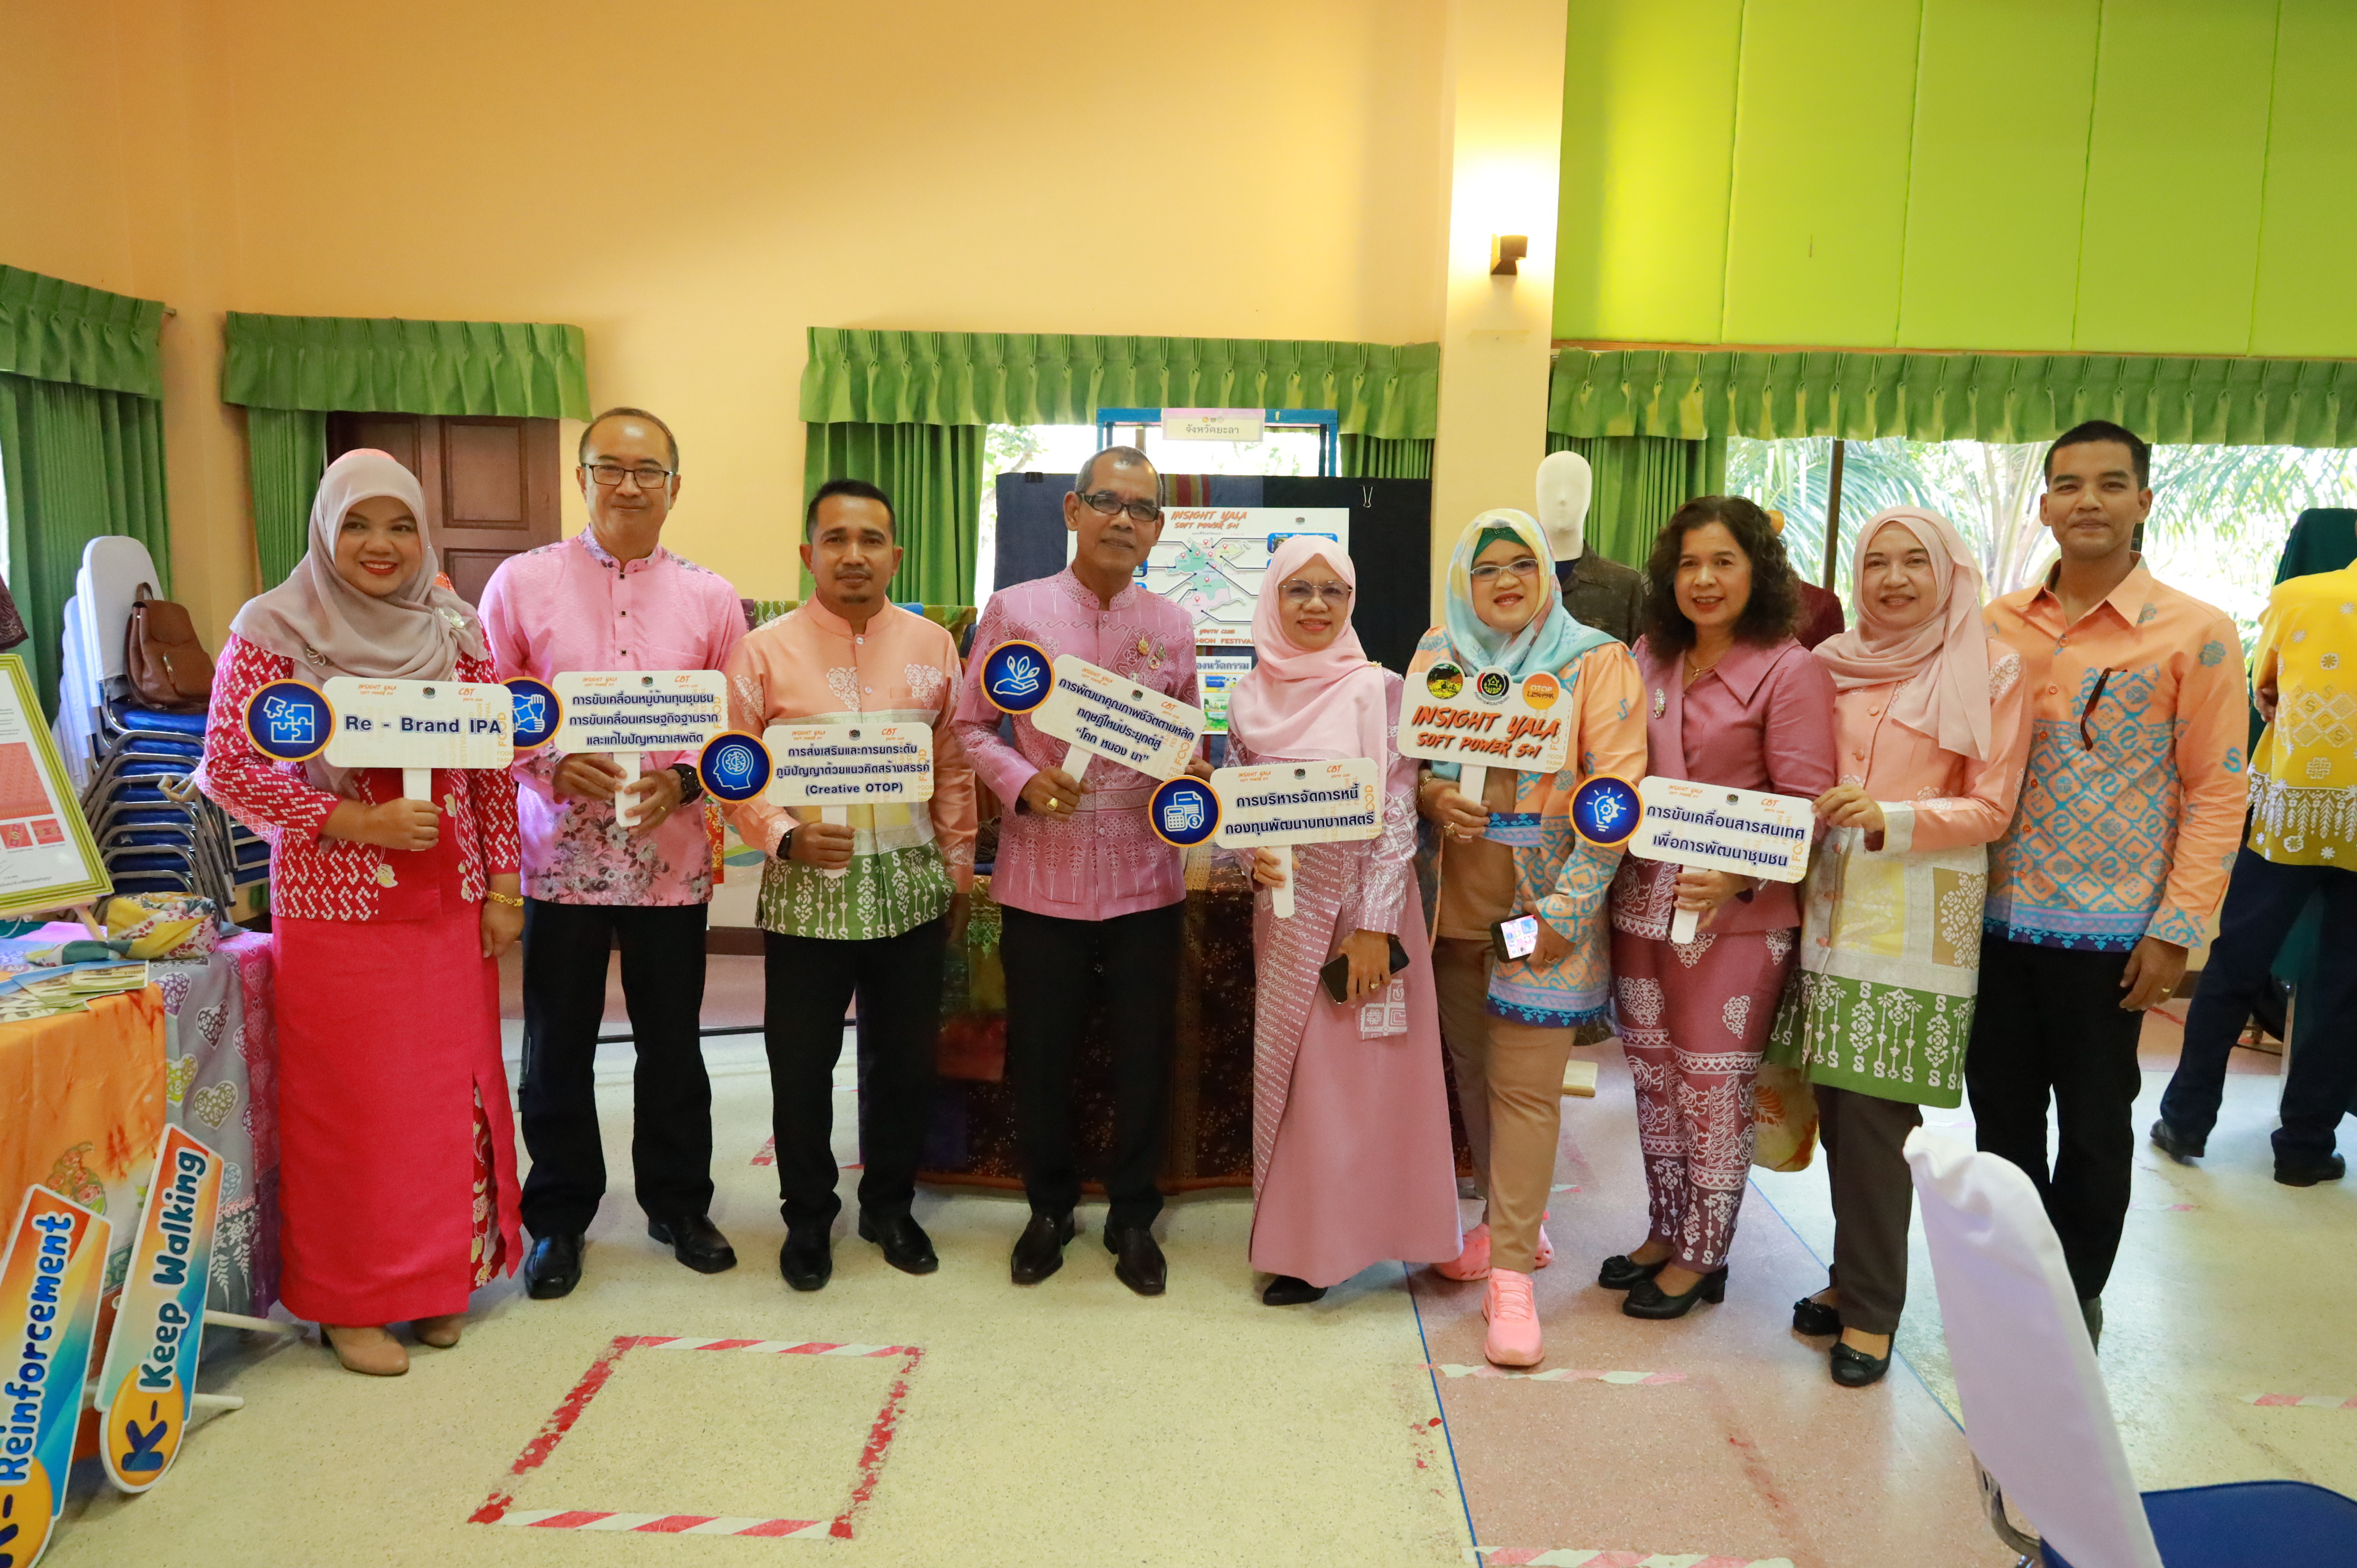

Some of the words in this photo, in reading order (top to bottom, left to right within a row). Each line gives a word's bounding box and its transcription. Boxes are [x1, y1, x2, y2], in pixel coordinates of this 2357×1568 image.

[1186, 424, 1239, 434] จังหวัดยะลา
[1171, 511, 1217, 520] INSIGHT
[1221, 512, 1248, 523] YALA
[1197, 659, 1249, 670] องนวัตกรรม
[1082, 668, 1101, 678] INSIGHT
[1101, 675, 1113, 684] YALA
[572, 691, 714, 706] การขับเคลื่อนหมู่บ้านทุนชุมชน
[1161, 701, 1177, 711] CBT
[569, 711, 718, 726] การขับเคลื่อนเศรษฐกิจฐานราก
[1058, 679, 1194, 741] การพัฒนาคุณภาพชีวิตตามหลัก
[344, 715, 373, 731] Re
[401, 716, 460, 733] Brand
[469, 718, 503, 734] IPA
[1411, 705, 1501, 732] INSIGHT
[1506, 715, 1561, 742] YALA
[587, 731, 703, 745] และแก้ไขปัญหายาเสพติด
[1076, 727, 1097, 744] “โคก
[1100, 739, 1128, 756] หนอง
[1131, 751, 1149, 762] นา”
[1416, 732, 1456, 749] SOFT
[1460, 736, 1512, 758] POWER
[788, 742, 917, 757] การส่งเสริมและการยกระดับ
[1174, 739, 1190, 766] FOO
[776, 760, 930, 778] ภูมิปัญญาด้วยแนวคิดสร้างสรรค์
[806, 785, 860, 796] (Creative
[866, 783, 903, 793] OTOP)
[1237, 783, 1359, 807] การบริหารจัดการหนี้
[1364, 785, 1375, 812] OOD
[1761, 799, 1779, 807] CBT
[1225, 811, 1374, 836] กองทุนพัฒนาบทบาทสตรี
[1647, 806, 1805, 840] การขับเคลื่อนสารสนเทศ
[1653, 832, 1788, 866] เพื่อการพัฒนาชุมชน
[154, 1150, 206, 1285] Walking
[0, 1216, 71, 1481] Reinforcement
[139, 1302, 189, 1388] Keep
